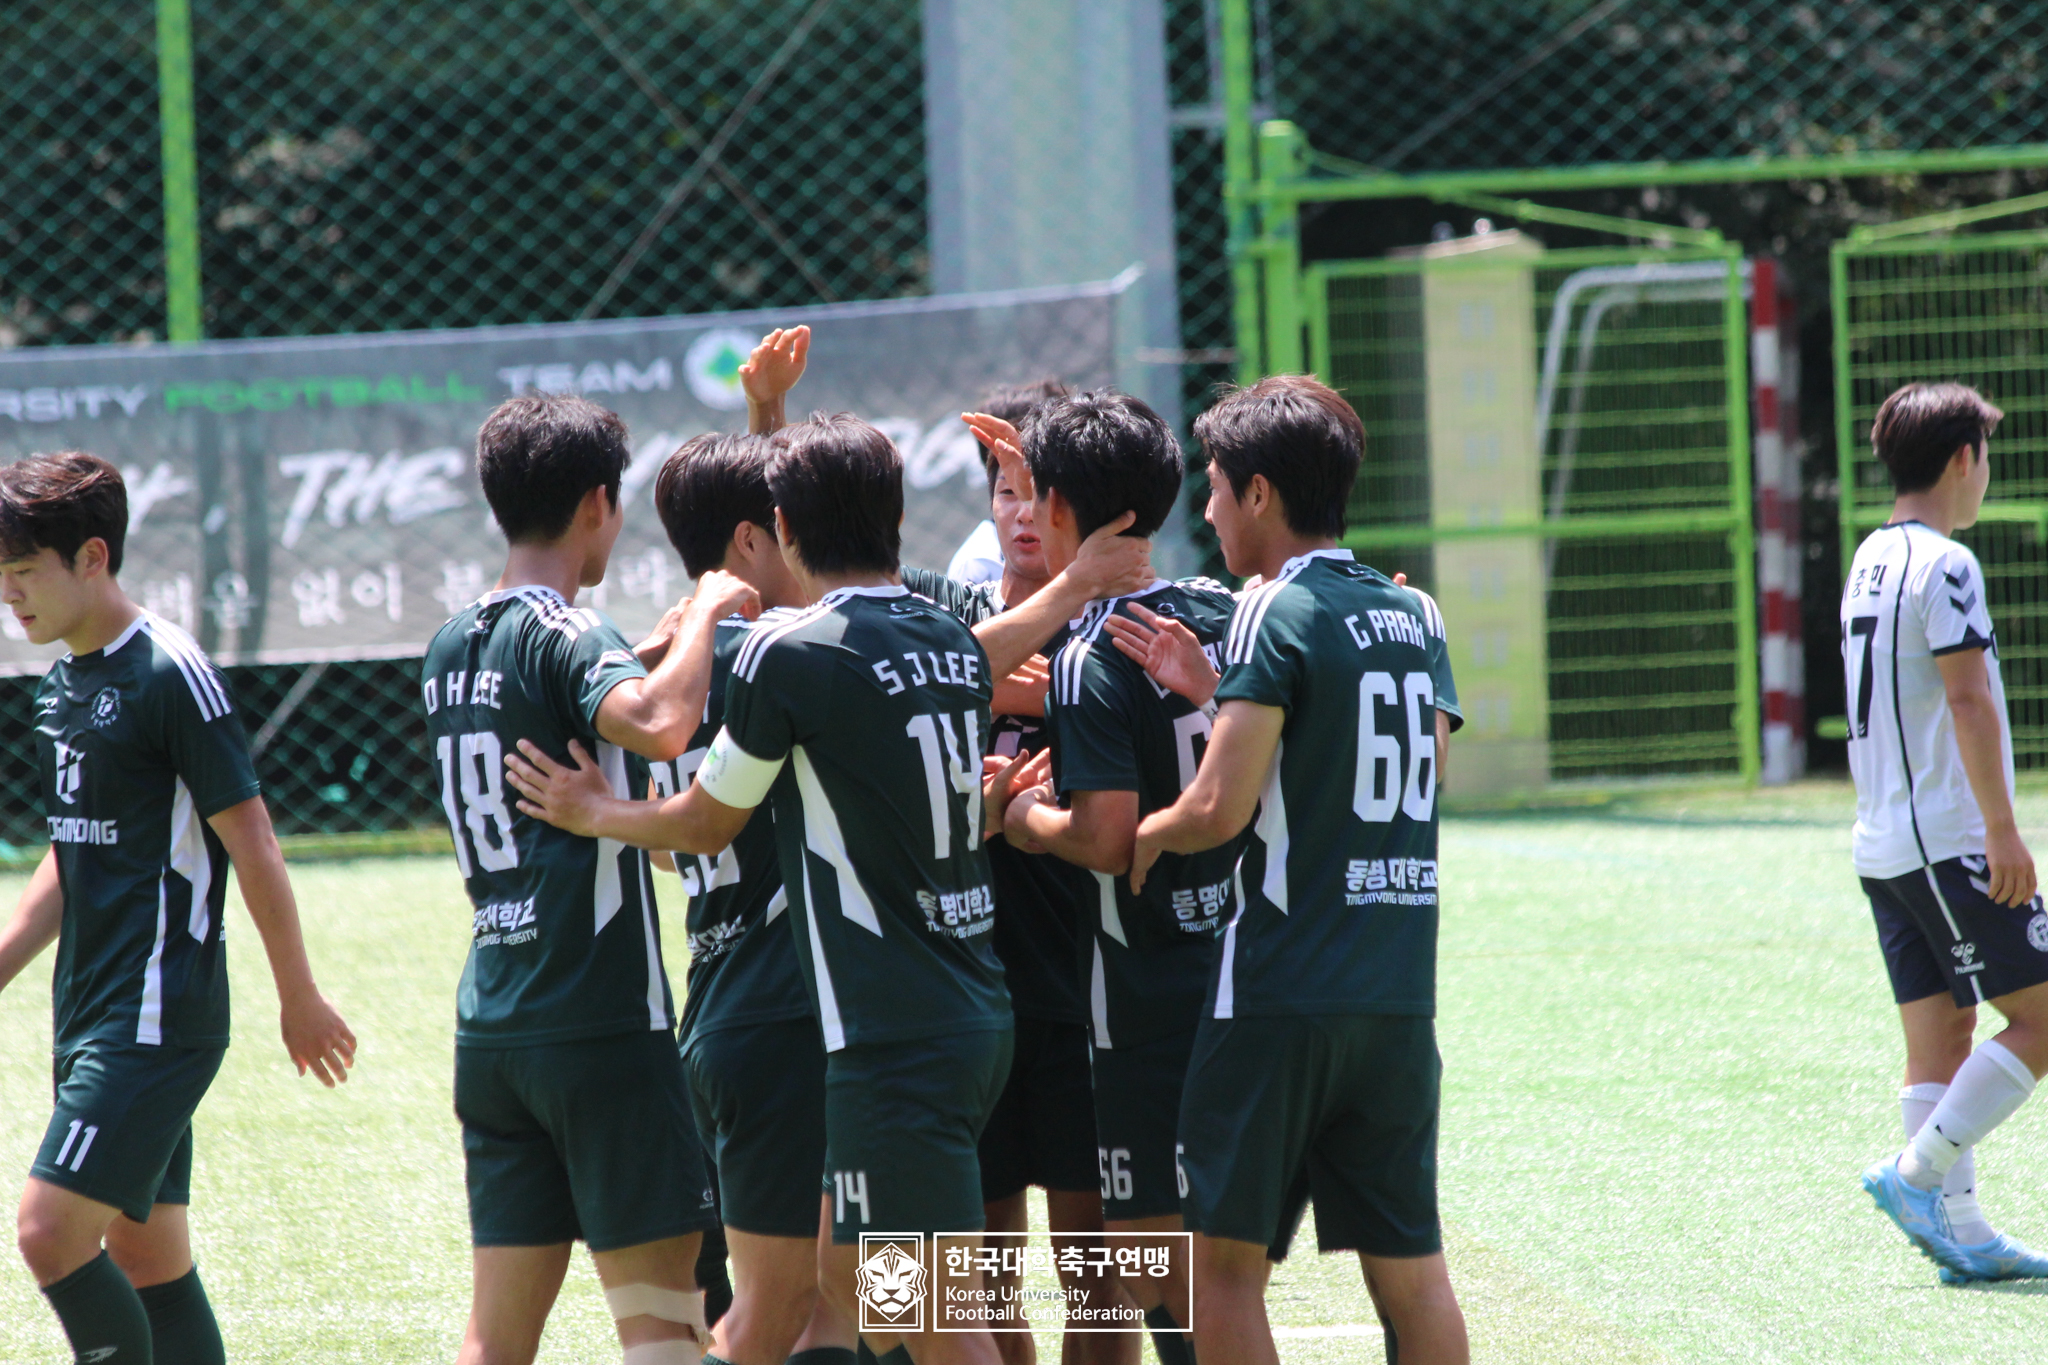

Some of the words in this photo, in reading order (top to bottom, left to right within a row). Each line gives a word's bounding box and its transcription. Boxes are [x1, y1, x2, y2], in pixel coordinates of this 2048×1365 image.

[164, 372, 487, 414] FOOTBALL
[498, 358, 674, 395] TEAM
[277, 447, 472, 549] THE
[1365, 609, 1427, 651] PARK
[446, 670, 467, 707] H
[469, 669, 503, 711] LEE
[871, 659, 905, 696] S
[903, 652, 929, 686] J
[927, 651, 981, 690] LEE
[1840, 616, 1879, 740] 7
[1352, 671, 1435, 823] 66
[436, 731, 521, 881] 18
[905, 709, 986, 861] 14
[1345, 857, 1438, 892] 동명대학교
[54, 1119, 98, 1173] 11
[834, 1170, 871, 1225] 14
